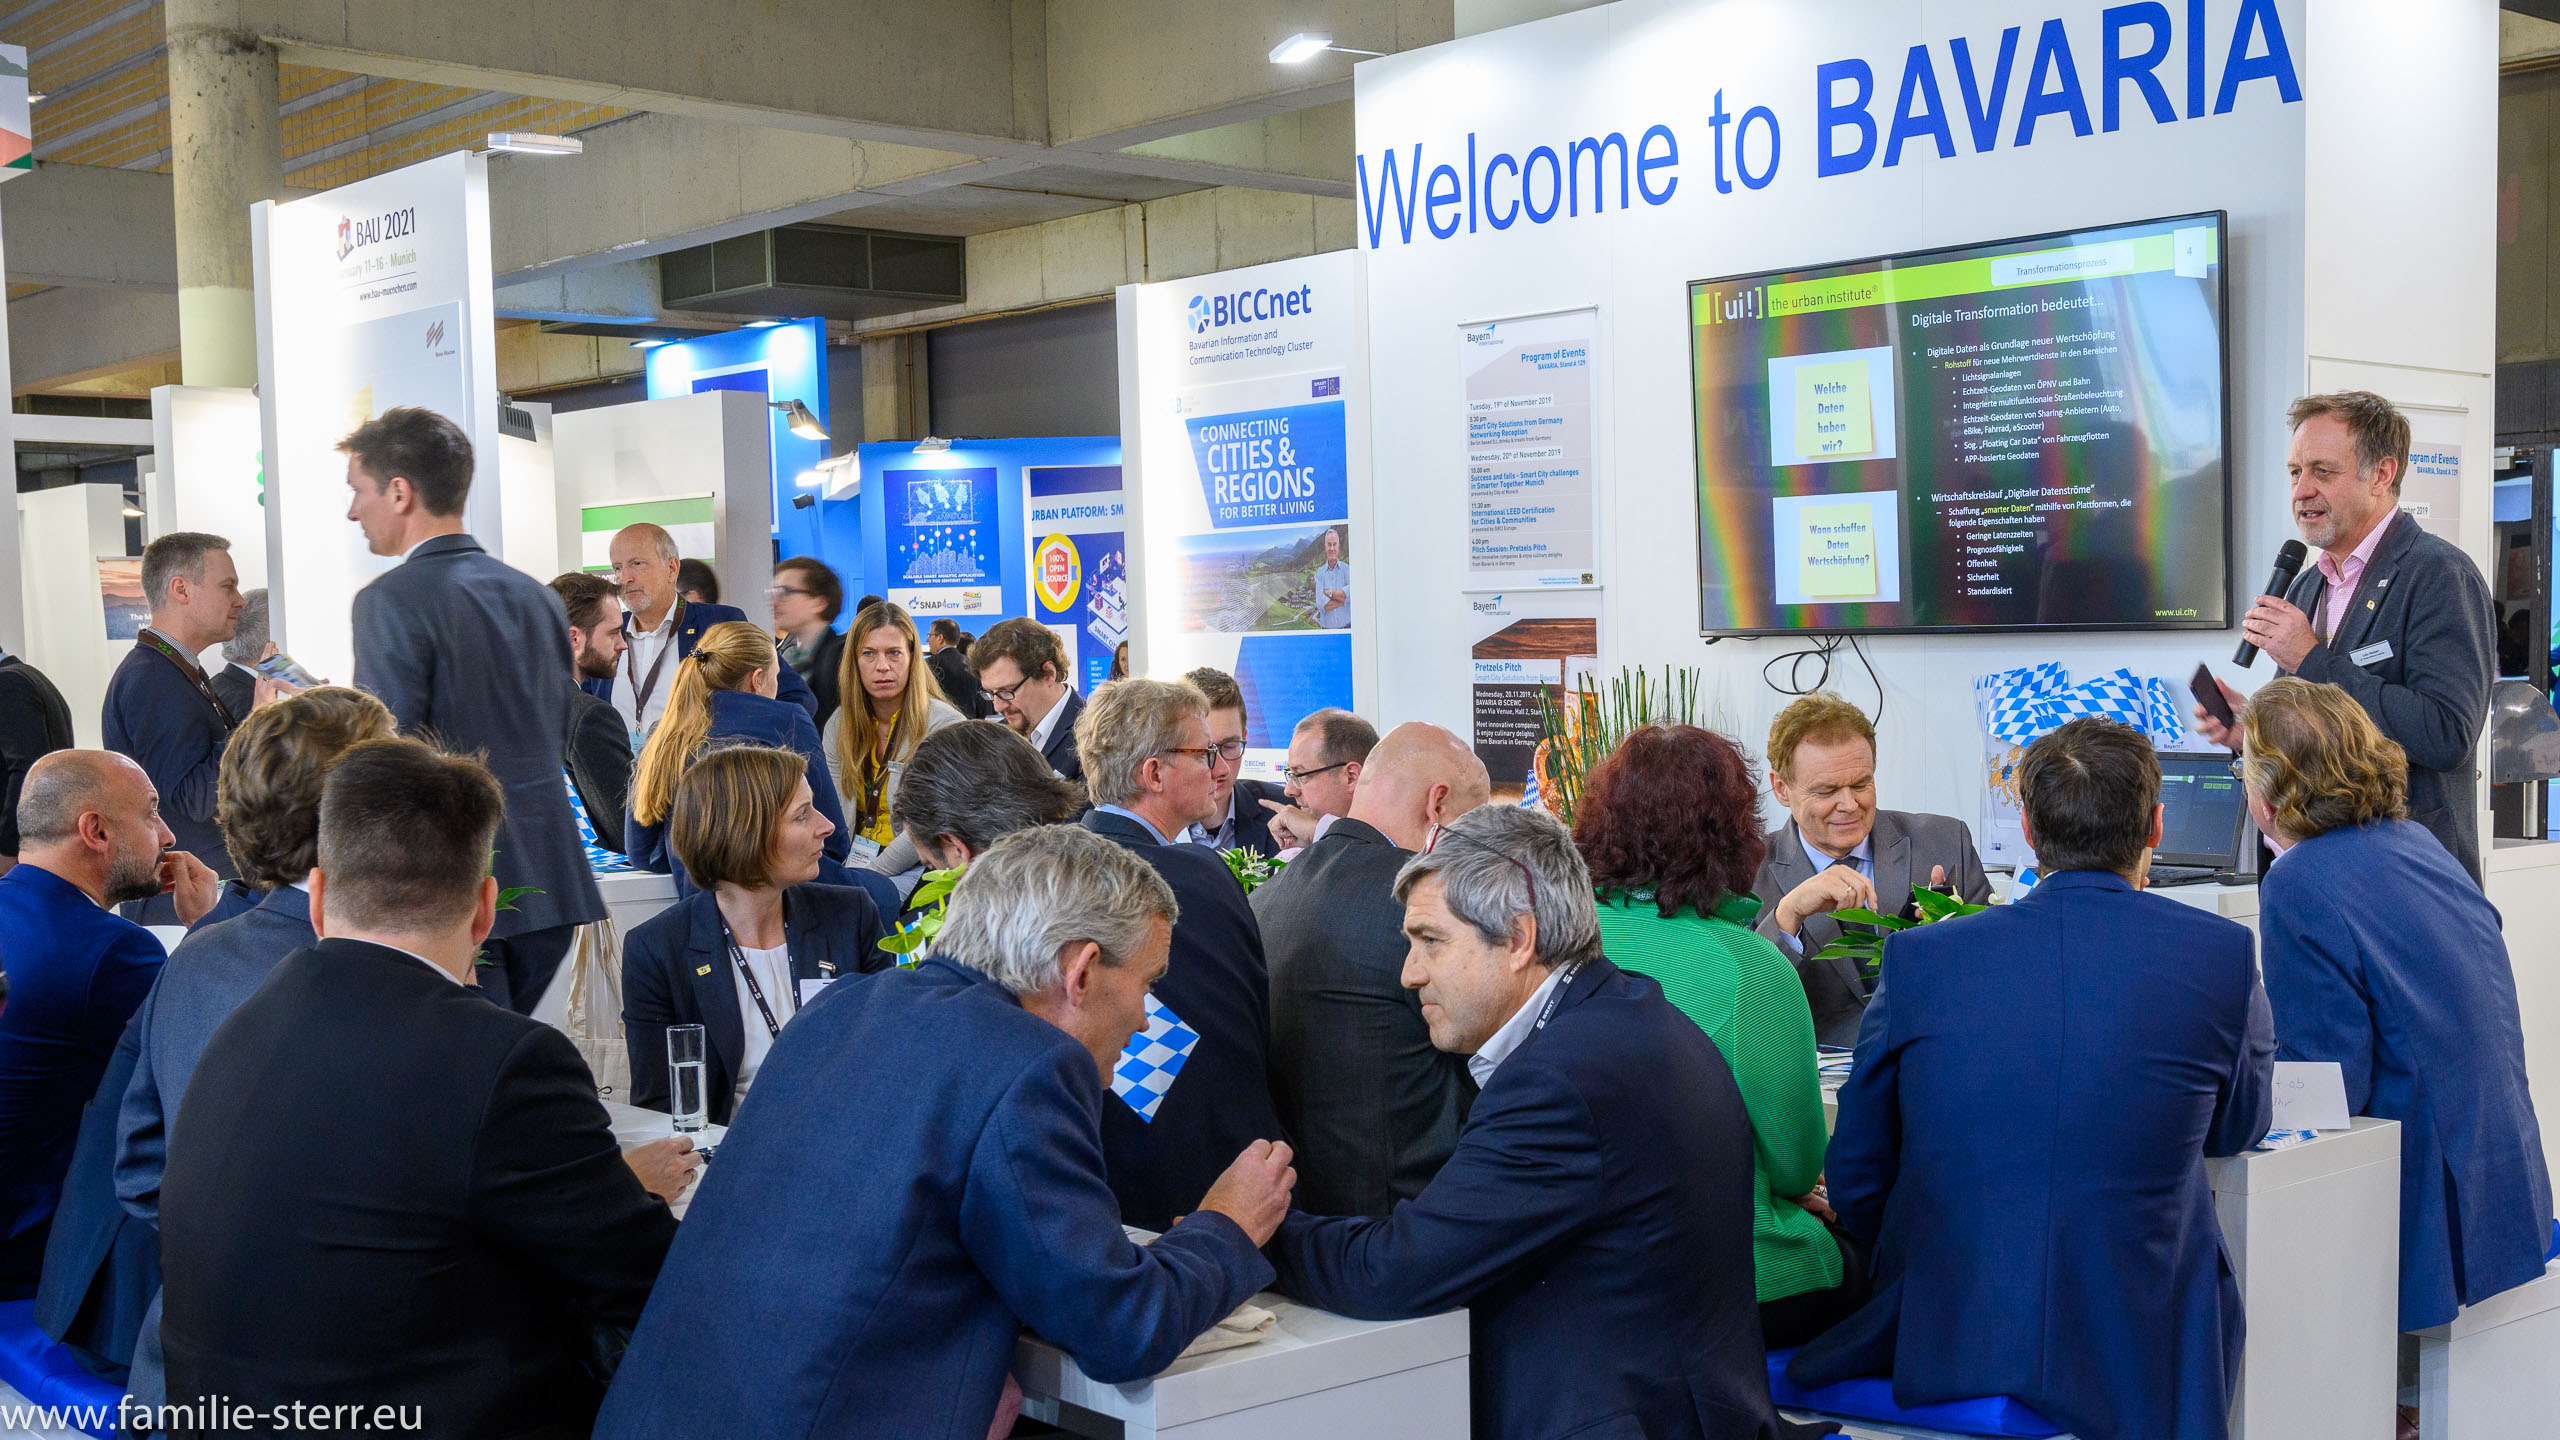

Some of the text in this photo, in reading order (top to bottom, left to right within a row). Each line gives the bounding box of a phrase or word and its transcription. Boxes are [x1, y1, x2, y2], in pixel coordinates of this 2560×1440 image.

[1357, 0, 2303, 250] Welcome to BAVARIA
[357, 207, 415, 247] BAU 2021
[390, 248, 416, 267] Munich
[2017, 258, 2107, 277] Transformationsprozess
[1214, 284, 1311, 327] BICCnet
[1772, 294, 1823, 310] the urban
[1912, 301, 2038, 328] Digitale Transformation
[1190, 329, 1278, 351] Bavarian Information and
[1468, 333, 1490, 343] Bayern
[1927, 330, 2115, 358] Digitale Daten als Grundlage neuer Wertschöpfung
[1190, 341, 1313, 365] Communication Technology Cluster
[1522, 348, 1585, 363] Program Events
[1945, 346, 2117, 369] Rohstoff für neue Mehrwertdienste den Bereichen
[1963, 370, 2021, 383] Lichtsignalanlagen
[1815, 383, 1847, 395] Welche
[1963, 377, 2091, 396] Echtzeit-Geodaten von ÖPNV und Bahn
[1470, 403, 1492, 411] Tuesday,
[1511, 398, 1537, 407] November
[1963, 389, 2123, 410] Integrierte multifunktionale Straßenbeleuchtung
[1818, 404, 1844, 414] Daten
[1964, 404, 2121, 424] Echtzeit-Geodaten von Sharing-Anbietern (Auto,
[1498, 416, 1563, 428] Solutions Germany
[1818, 422, 1846, 433] haben
[1201, 417, 1289, 443] CONNECTING
[1470, 431, 1500, 439] Networking
[1964, 422, 2044, 436] eBike, Fahrrad, eScooter)
[1822, 440, 1843, 451] wir?
[1964, 431, 2109, 450] Sog. Car von Fahrzeugflotten
[1208, 437, 1296, 473] CITIES &
[1471, 448, 1561, 462] Wednesday, November 2019
[1965, 451, 2039, 463] APP-basierte Geodaten
[2431, 453, 2458, 465] of Events
[1549, 469, 1579, 477] challenges
[1215, 467, 1315, 504] REGIONS
[1500, 481, 1524, 489] Together
[1932, 489, 2003, 502] Wirtschaftskreislauf
[1062, 506, 1107, 519] PLATFORM:
[1220, 500, 1314, 519] FOR BETTER LIVING
[1472, 506, 1554, 516] International Certification
[1949, 500, 2118, 516] Schaffung mithilfe Plattformen,
[1502, 516, 1536, 524] Communities
[1949, 514, 2044, 528] folgende Eigenschaften haben
[1810, 524, 1866, 534] Wann schaffen
[1966, 530, 2033, 542] Geringe Latenzzeiten
[1510, 544, 1532, 552] Pretzels
[1827, 540, 1849, 549] Daten
[1966, 544, 2024, 555] Prognosefähigkeit
[1049, 554, 1065, 563] 100%
[1808, 554, 1869, 567] Wertschöpfung?
[1966, 559, 1997, 568] Offenheit
[1049, 564, 1065, 573] OPEN
[1046, 574, 1068, 582] SOURCE
[1967, 573, 1999, 582] Sicherheit
[1968, 587, 2012, 596] Standardisiert
[1473, 602, 1496, 612] Bayern
[2155, 608, 2197, 618] www.ui.city
[1094, 626, 1109, 643] SMART
[1475, 663, 1521, 671] Pretzels Pitch
[1476, 691, 1504, 699] Wednesday,
